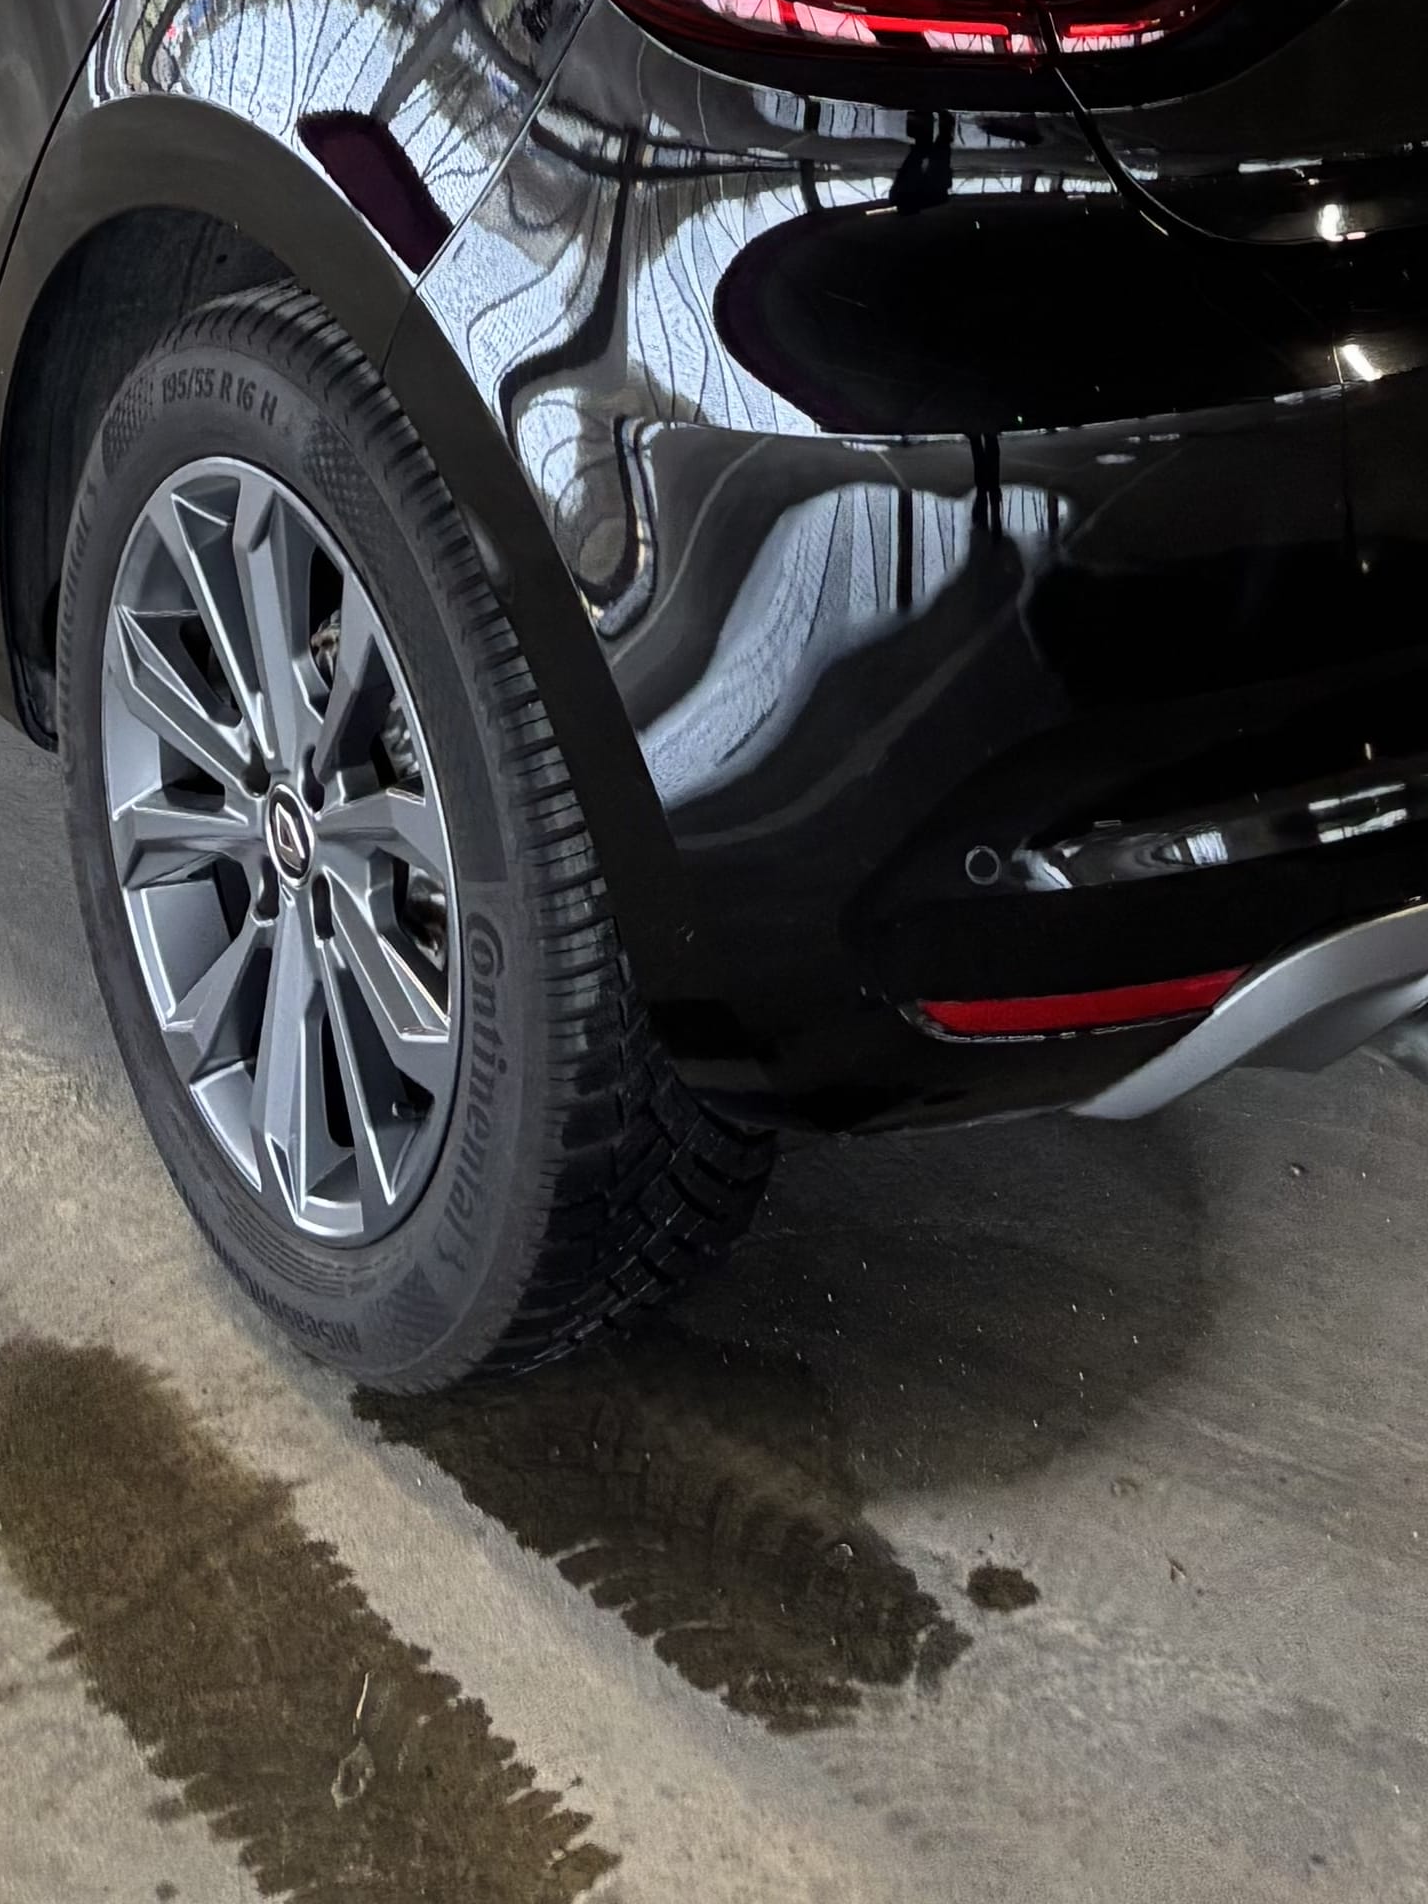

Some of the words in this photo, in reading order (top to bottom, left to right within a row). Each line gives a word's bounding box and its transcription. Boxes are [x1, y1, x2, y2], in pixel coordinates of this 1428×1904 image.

[162, 367, 216, 404] 195/55
[219, 370, 233, 404] R
[237, 377, 257, 411] 16
